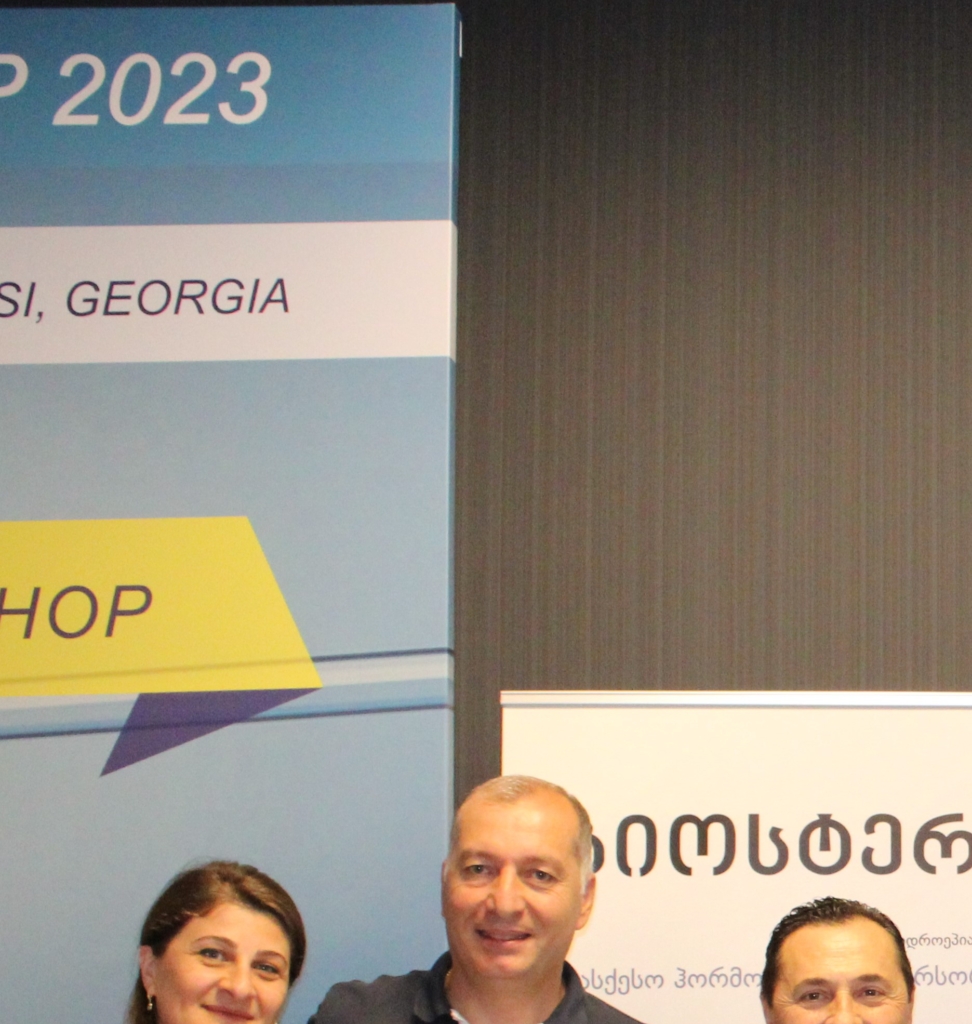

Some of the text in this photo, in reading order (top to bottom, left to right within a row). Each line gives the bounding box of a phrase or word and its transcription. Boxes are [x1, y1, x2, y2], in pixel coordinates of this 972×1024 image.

[52, 52, 272, 126] 2023
[66, 278, 290, 317] GEORGIA
[0, 585, 153, 639] HOP
